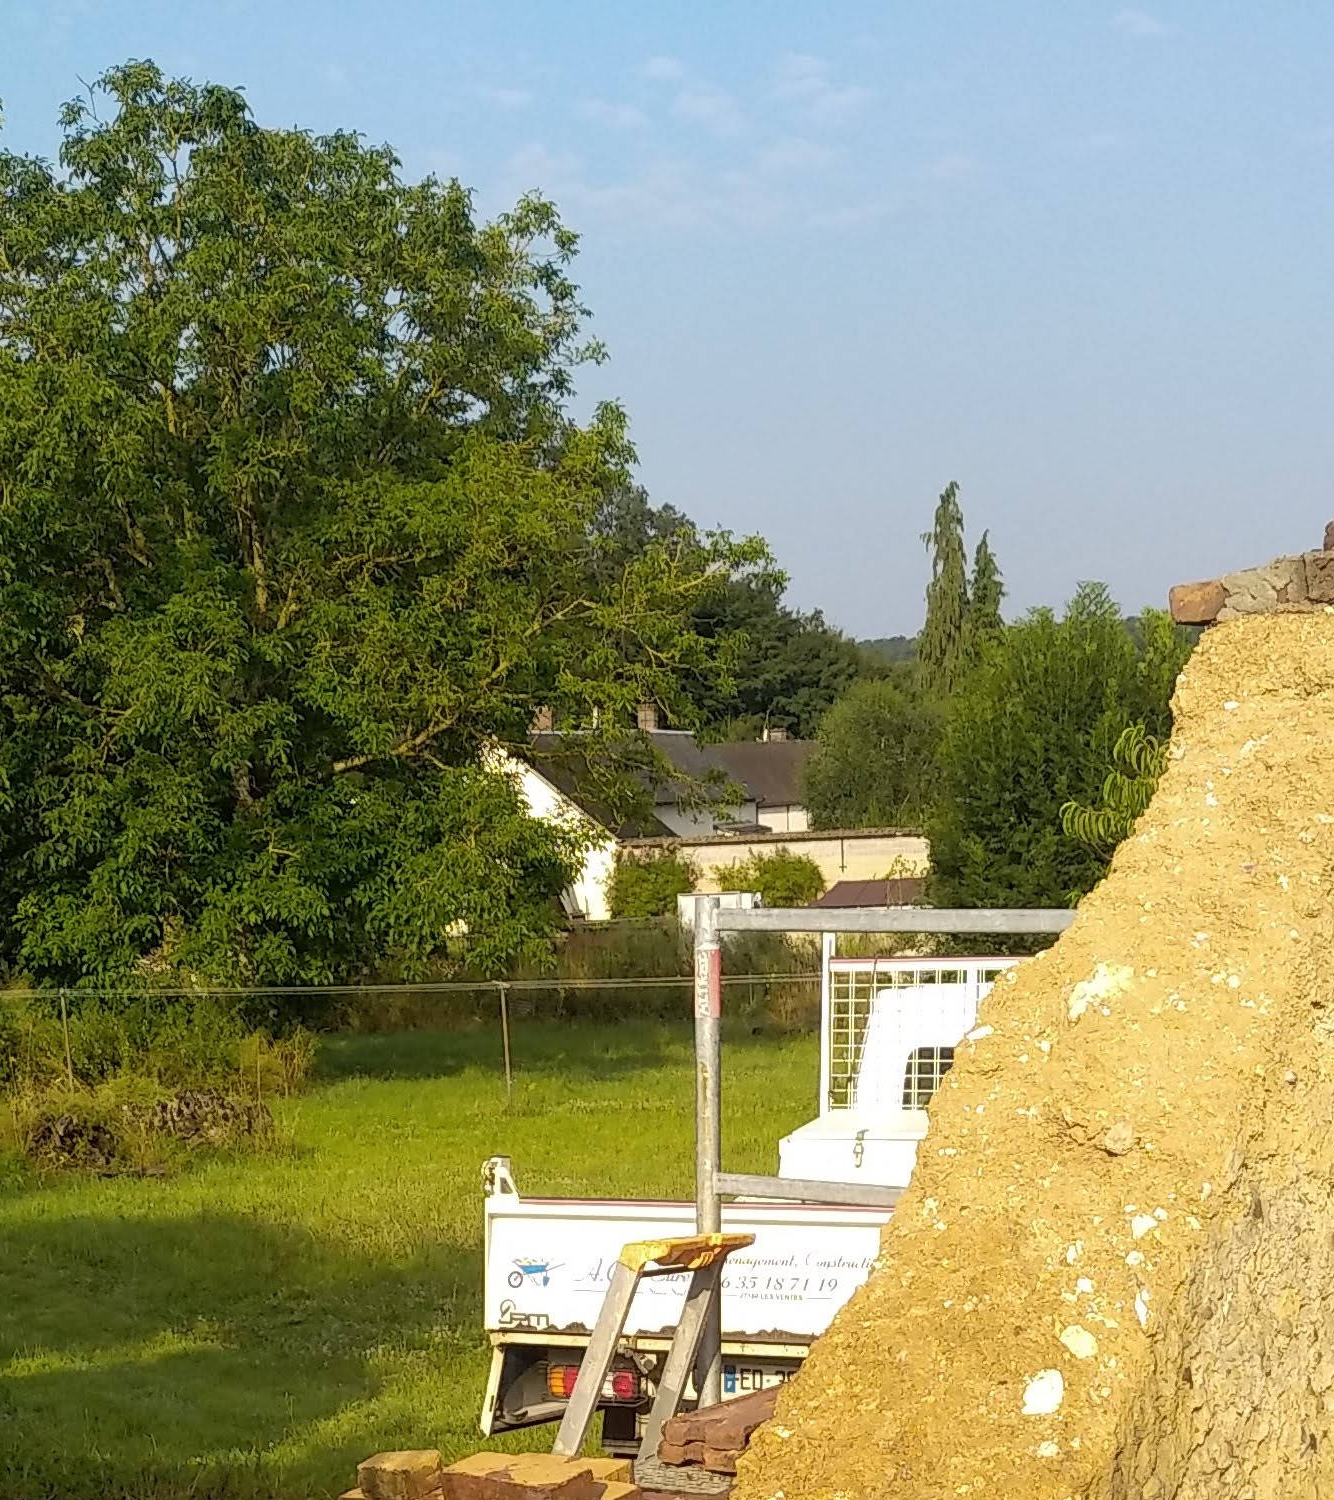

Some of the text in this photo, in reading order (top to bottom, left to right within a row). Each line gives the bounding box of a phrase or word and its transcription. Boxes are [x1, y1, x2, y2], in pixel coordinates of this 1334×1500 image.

[735, 1275, 758, 1289] 35
[765, 1276, 784, 1291] 18
[790, 1277, 810, 1291] 71
[818, 1278, 838, 1292] 19
